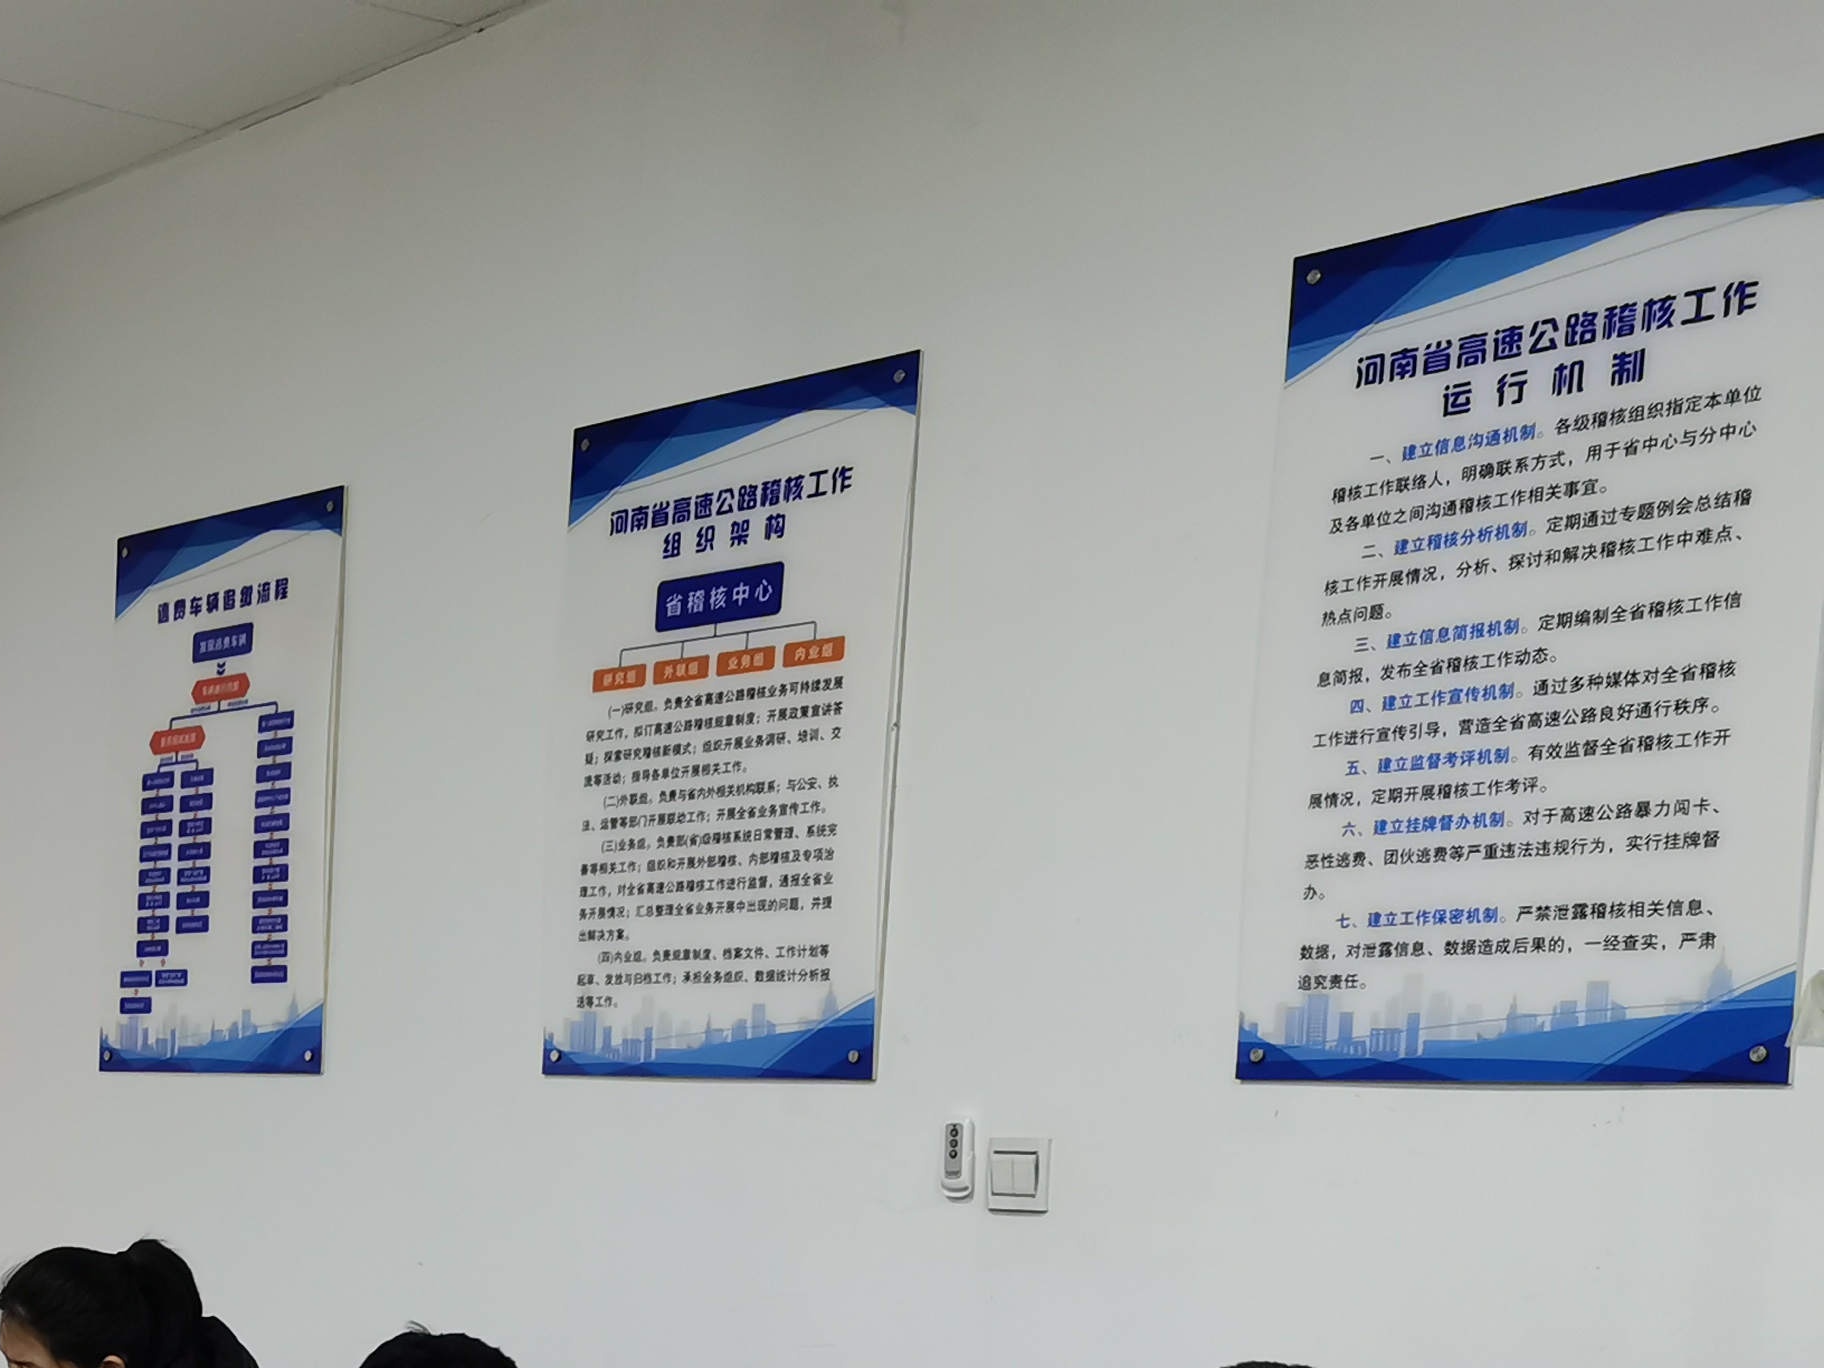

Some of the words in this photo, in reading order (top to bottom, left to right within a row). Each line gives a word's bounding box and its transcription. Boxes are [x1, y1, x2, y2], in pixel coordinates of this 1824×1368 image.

[1355, 280, 1759, 389] 河南省高速公路稽核工作
[1442, 349, 1646, 417] 运行机制
[610, 466, 854, 536] 河南省高速公路稽核工作
[1329, 478, 1608, 534] 及各单位之间沟通稽核工作相关事宜。
[663, 513, 786, 560] 组织架构
[666, 578, 773, 618] 省稽核中心
[1321, 603, 1393, 627] 热点问题。
[1317, 647, 1557, 688] 息简报，发布全省稽核工作动态。
[1307, 776, 1547, 810] 展情况，定期开展稽核工作考评。
[1302, 884, 1326, 901] 办。
[1297, 973, 1368, 992] 追究责任。
